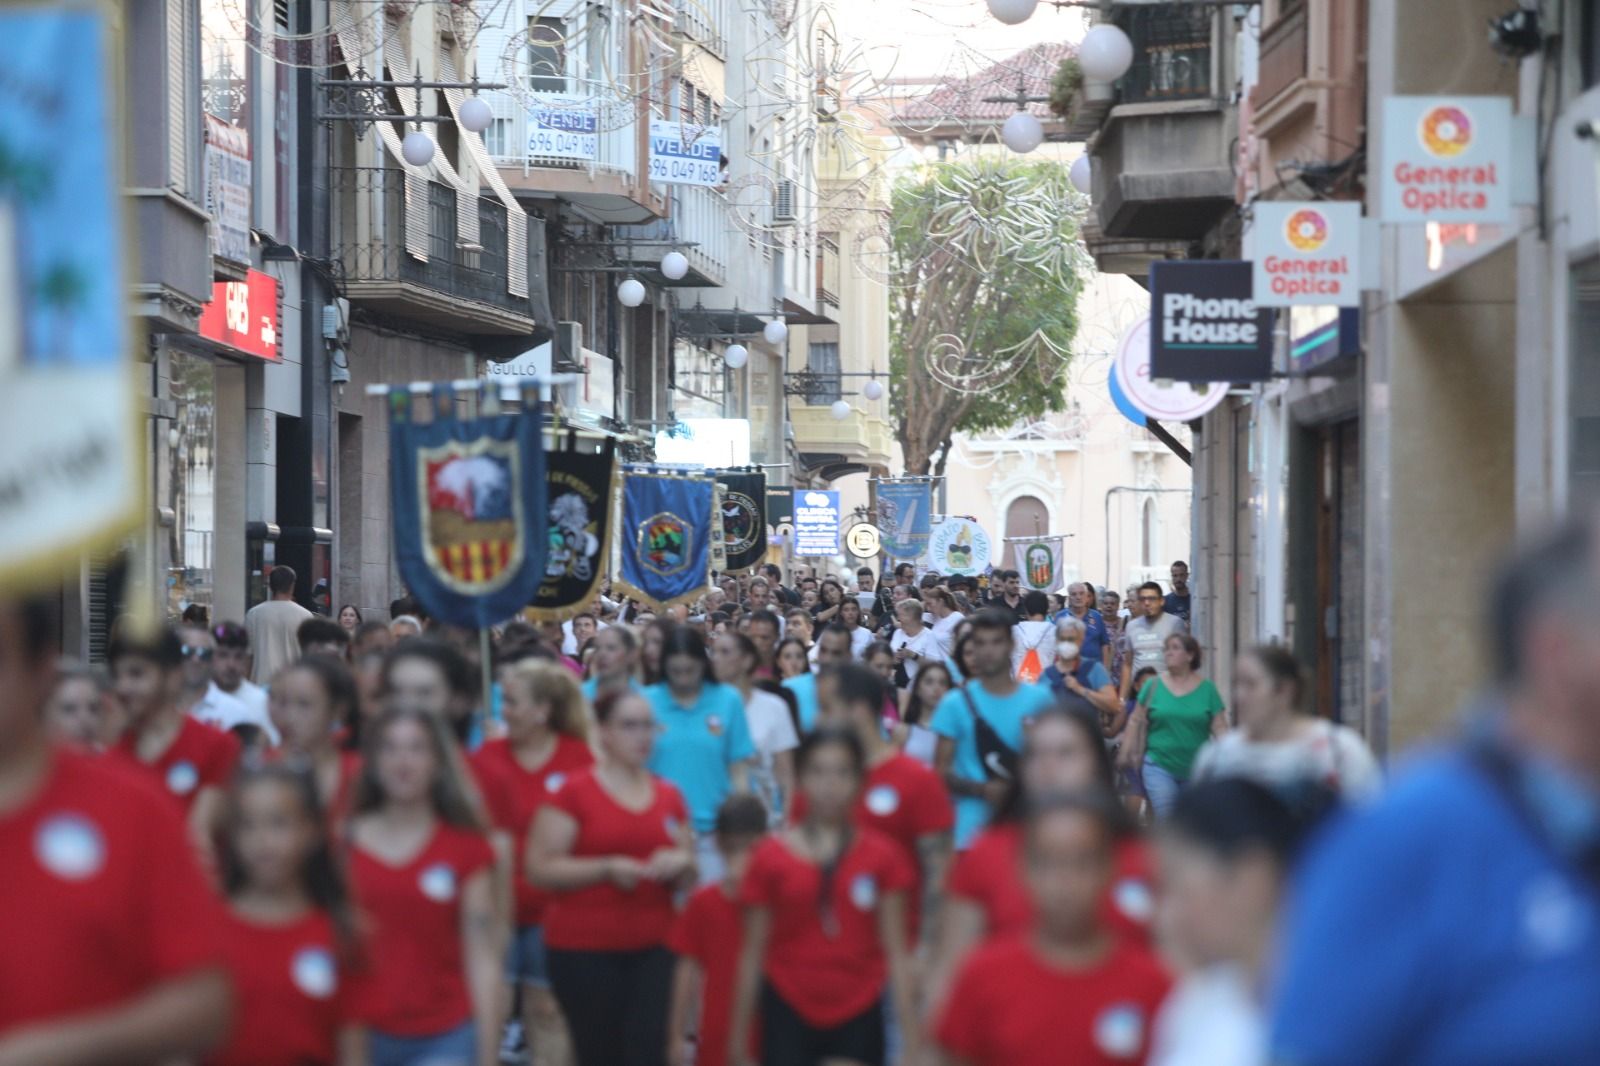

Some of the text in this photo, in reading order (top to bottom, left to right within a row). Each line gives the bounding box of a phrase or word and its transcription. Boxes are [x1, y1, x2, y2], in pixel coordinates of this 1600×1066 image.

[538, 112, 592, 131] VENDE
[528, 132, 596, 155] 696 049 168
[655, 138, 713, 158] VENDE
[672, 161, 695, 180] 049
[698, 163, 717, 183] 168
[1394, 162, 1497, 185] General
[1401, 187, 1488, 212] Optica
[1264, 255, 1348, 275] General
[1270, 276, 1341, 298] Optica
[1163, 293, 1258, 319] Phone
[1163, 318, 1258, 343] House
